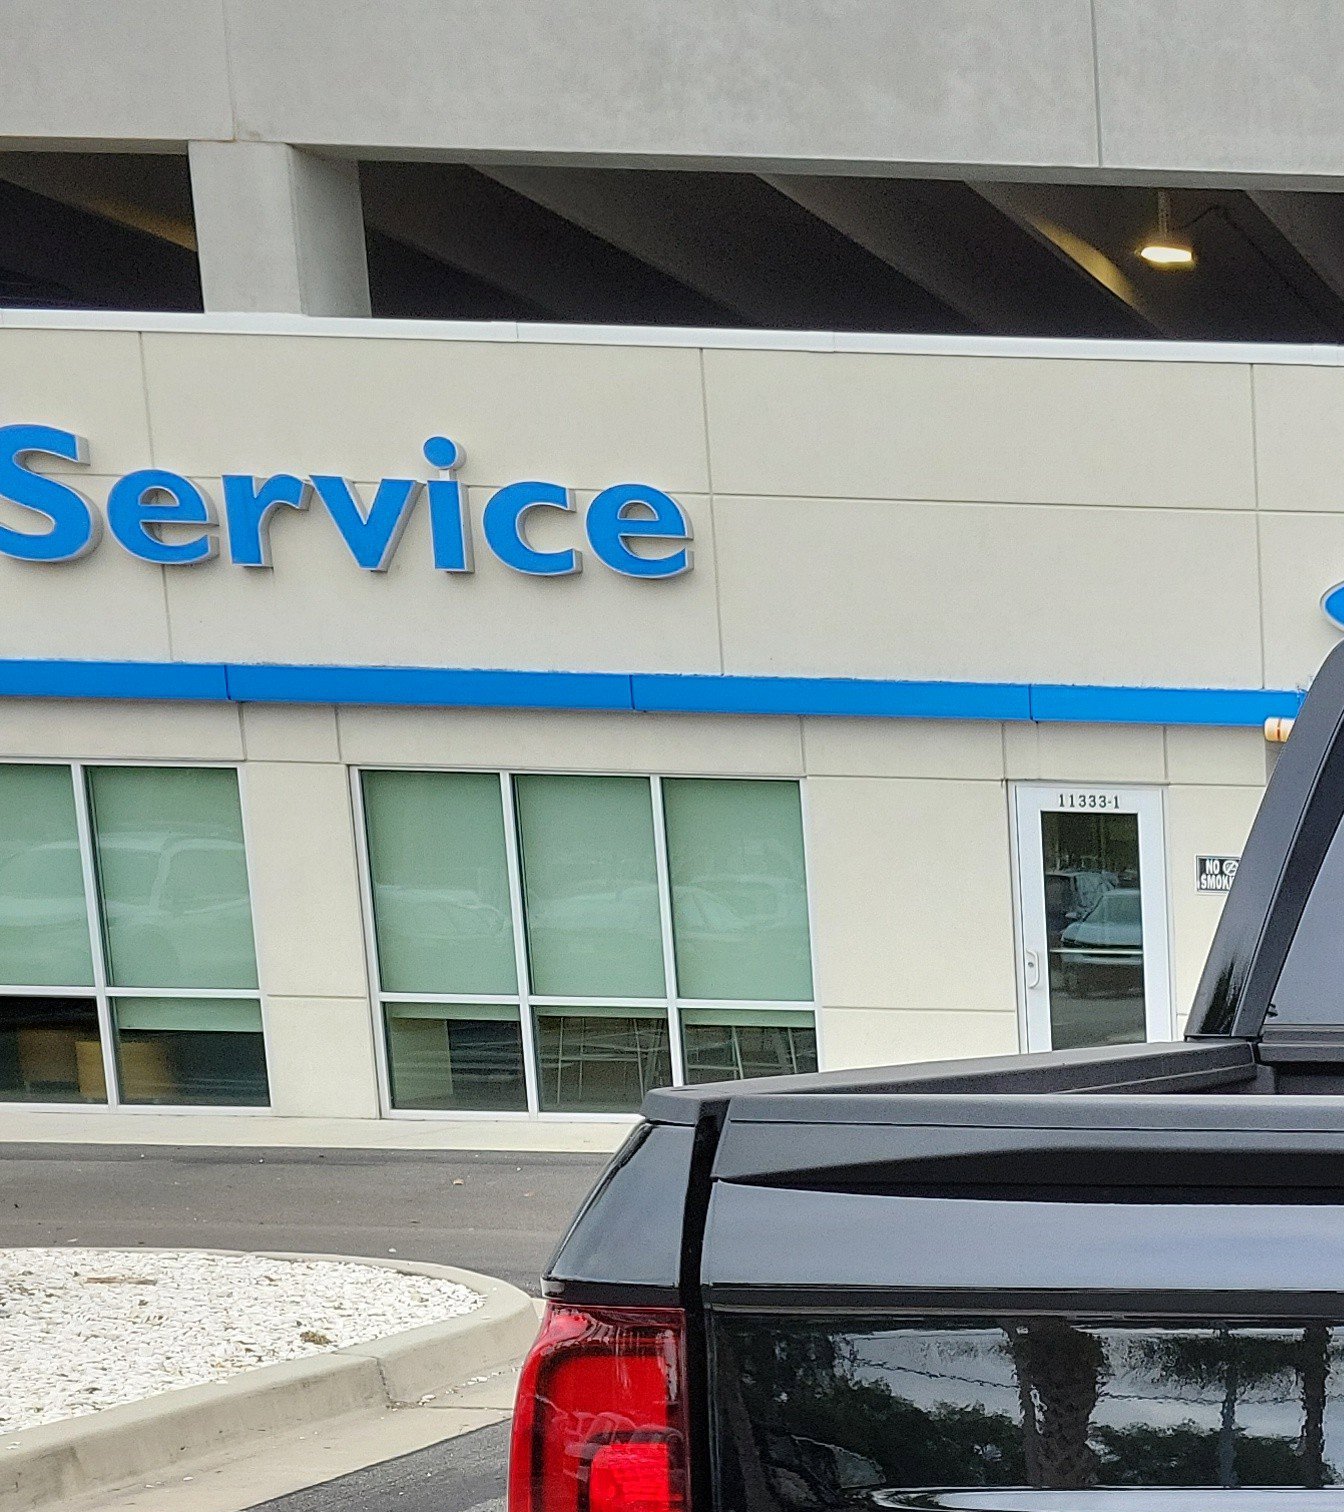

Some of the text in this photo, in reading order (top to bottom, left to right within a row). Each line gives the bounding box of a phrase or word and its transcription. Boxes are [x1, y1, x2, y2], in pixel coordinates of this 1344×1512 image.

[0, 423, 694, 579] Service
[1060, 793, 1119, 809] 11333-1
[1206, 860, 1220, 875] NO
